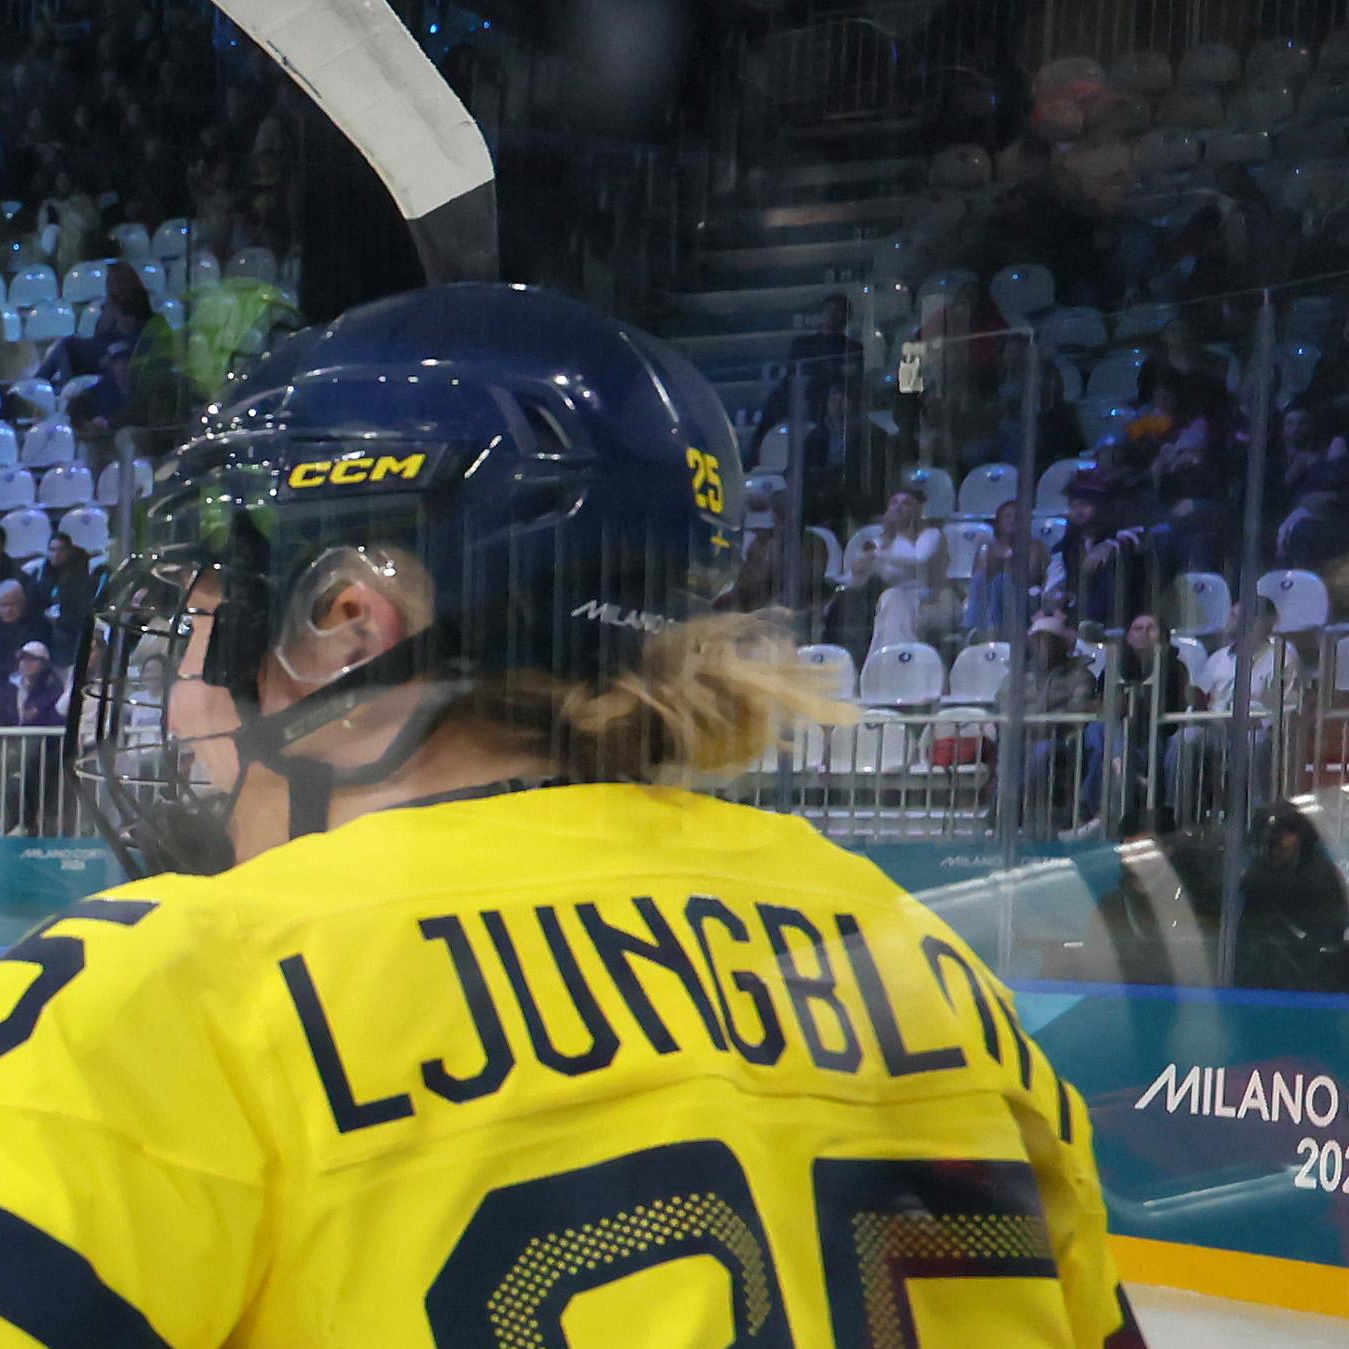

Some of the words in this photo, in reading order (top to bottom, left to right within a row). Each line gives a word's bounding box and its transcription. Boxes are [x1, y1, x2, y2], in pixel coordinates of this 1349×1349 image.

[287, 453, 426, 489] CCM
[686, 447, 724, 514] 25
[1134, 1063, 1339, 1128] MILANO
